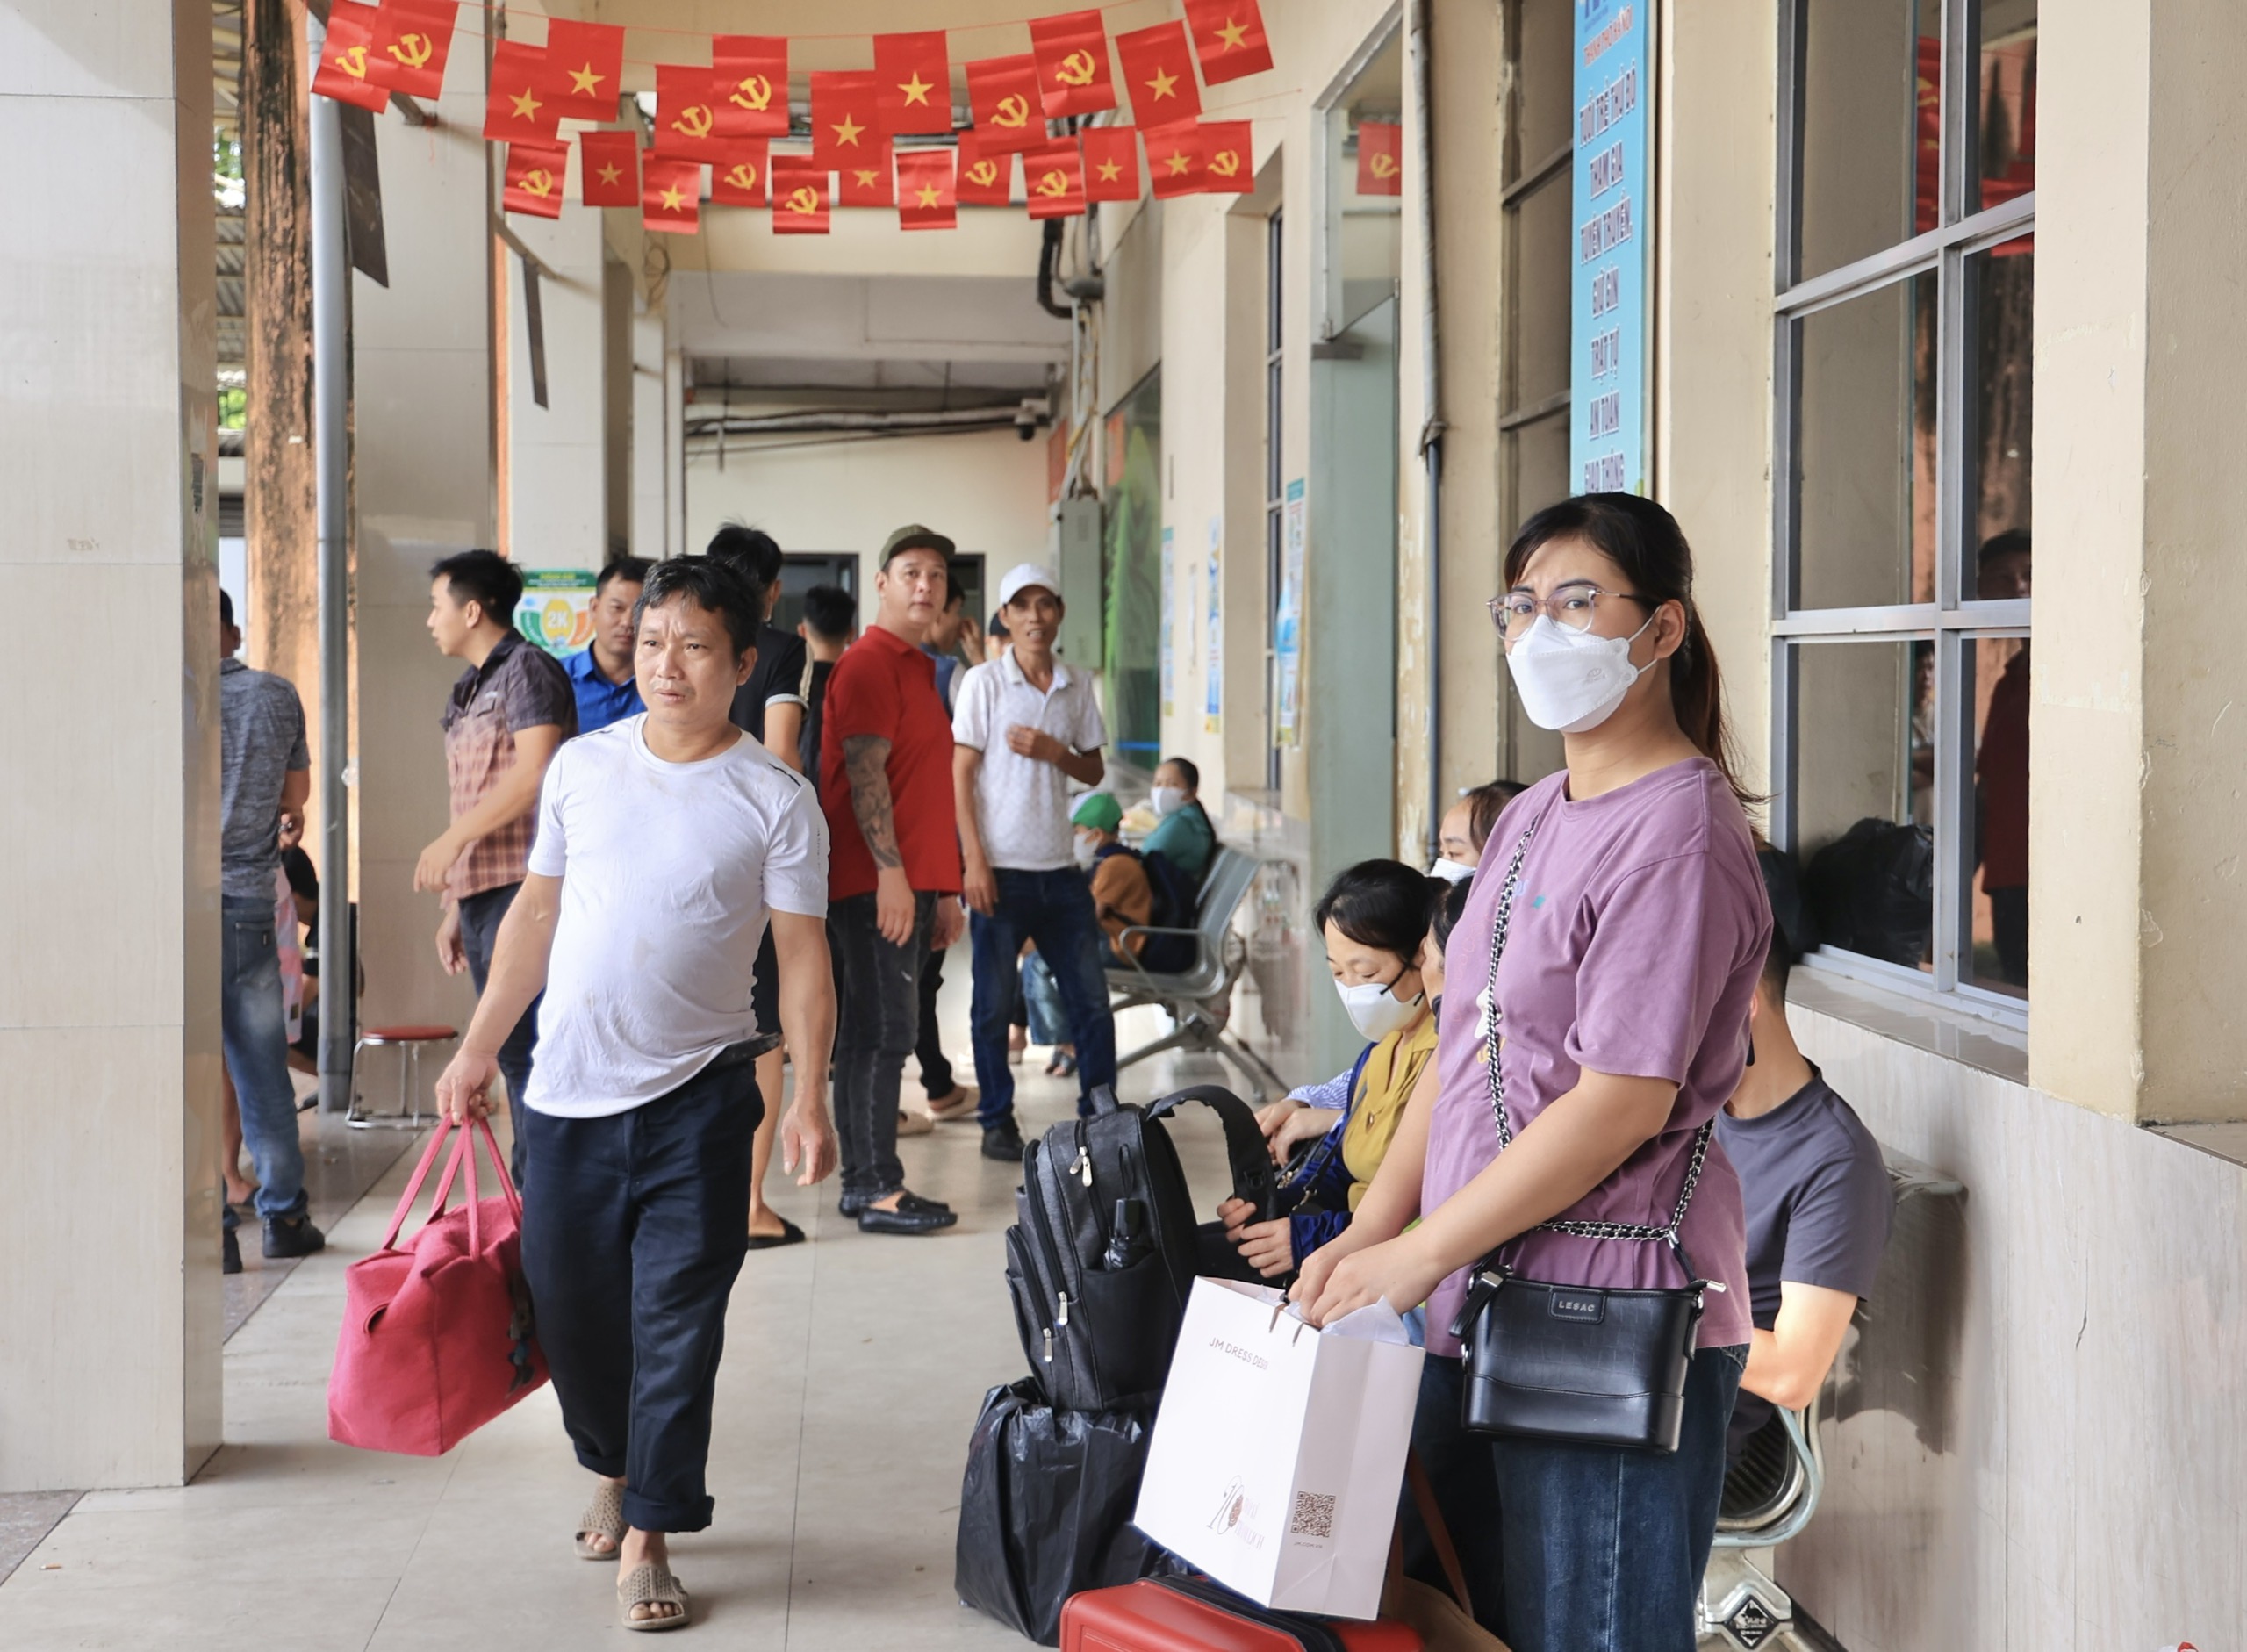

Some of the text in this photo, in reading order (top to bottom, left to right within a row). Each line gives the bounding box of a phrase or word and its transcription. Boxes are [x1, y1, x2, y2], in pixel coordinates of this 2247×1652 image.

[1596, 76, 1610, 137] TRẺ
[1590, 140, 1623, 201] THAM GIA
[1590, 385, 1619, 441] AN TOÀN
[1558, 1300, 1595, 1312] LESAC
[1209, 1337, 1224, 1350] JM
[1225, 1343, 1253, 1362] DRESS
